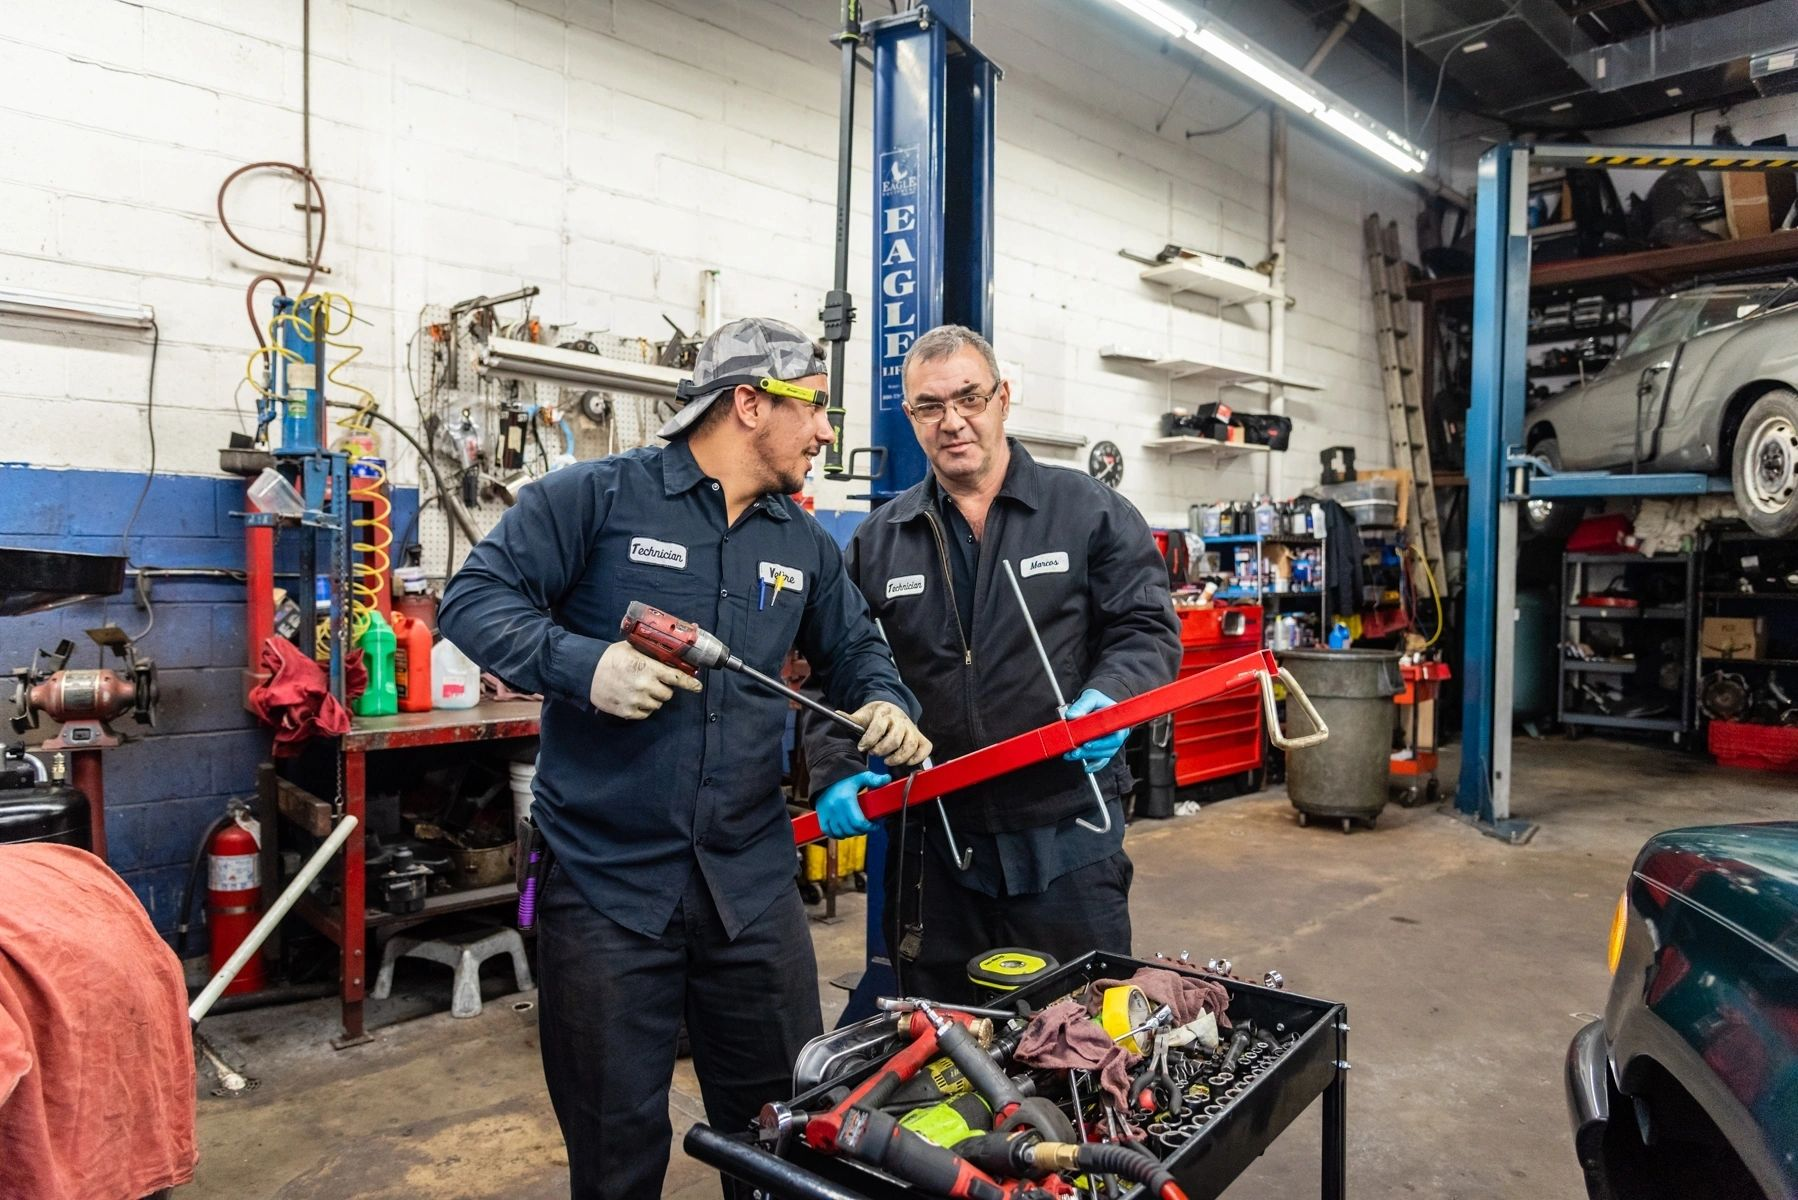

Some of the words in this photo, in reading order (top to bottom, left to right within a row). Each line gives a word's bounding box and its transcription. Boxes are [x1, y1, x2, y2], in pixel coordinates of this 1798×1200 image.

[882, 177, 917, 193] EAGLE
[882, 204, 916, 358] EAGLE
[631, 543, 684, 563] Technician
[1030, 559, 1060, 571] Marcos
[888, 581, 922, 593] Technician
